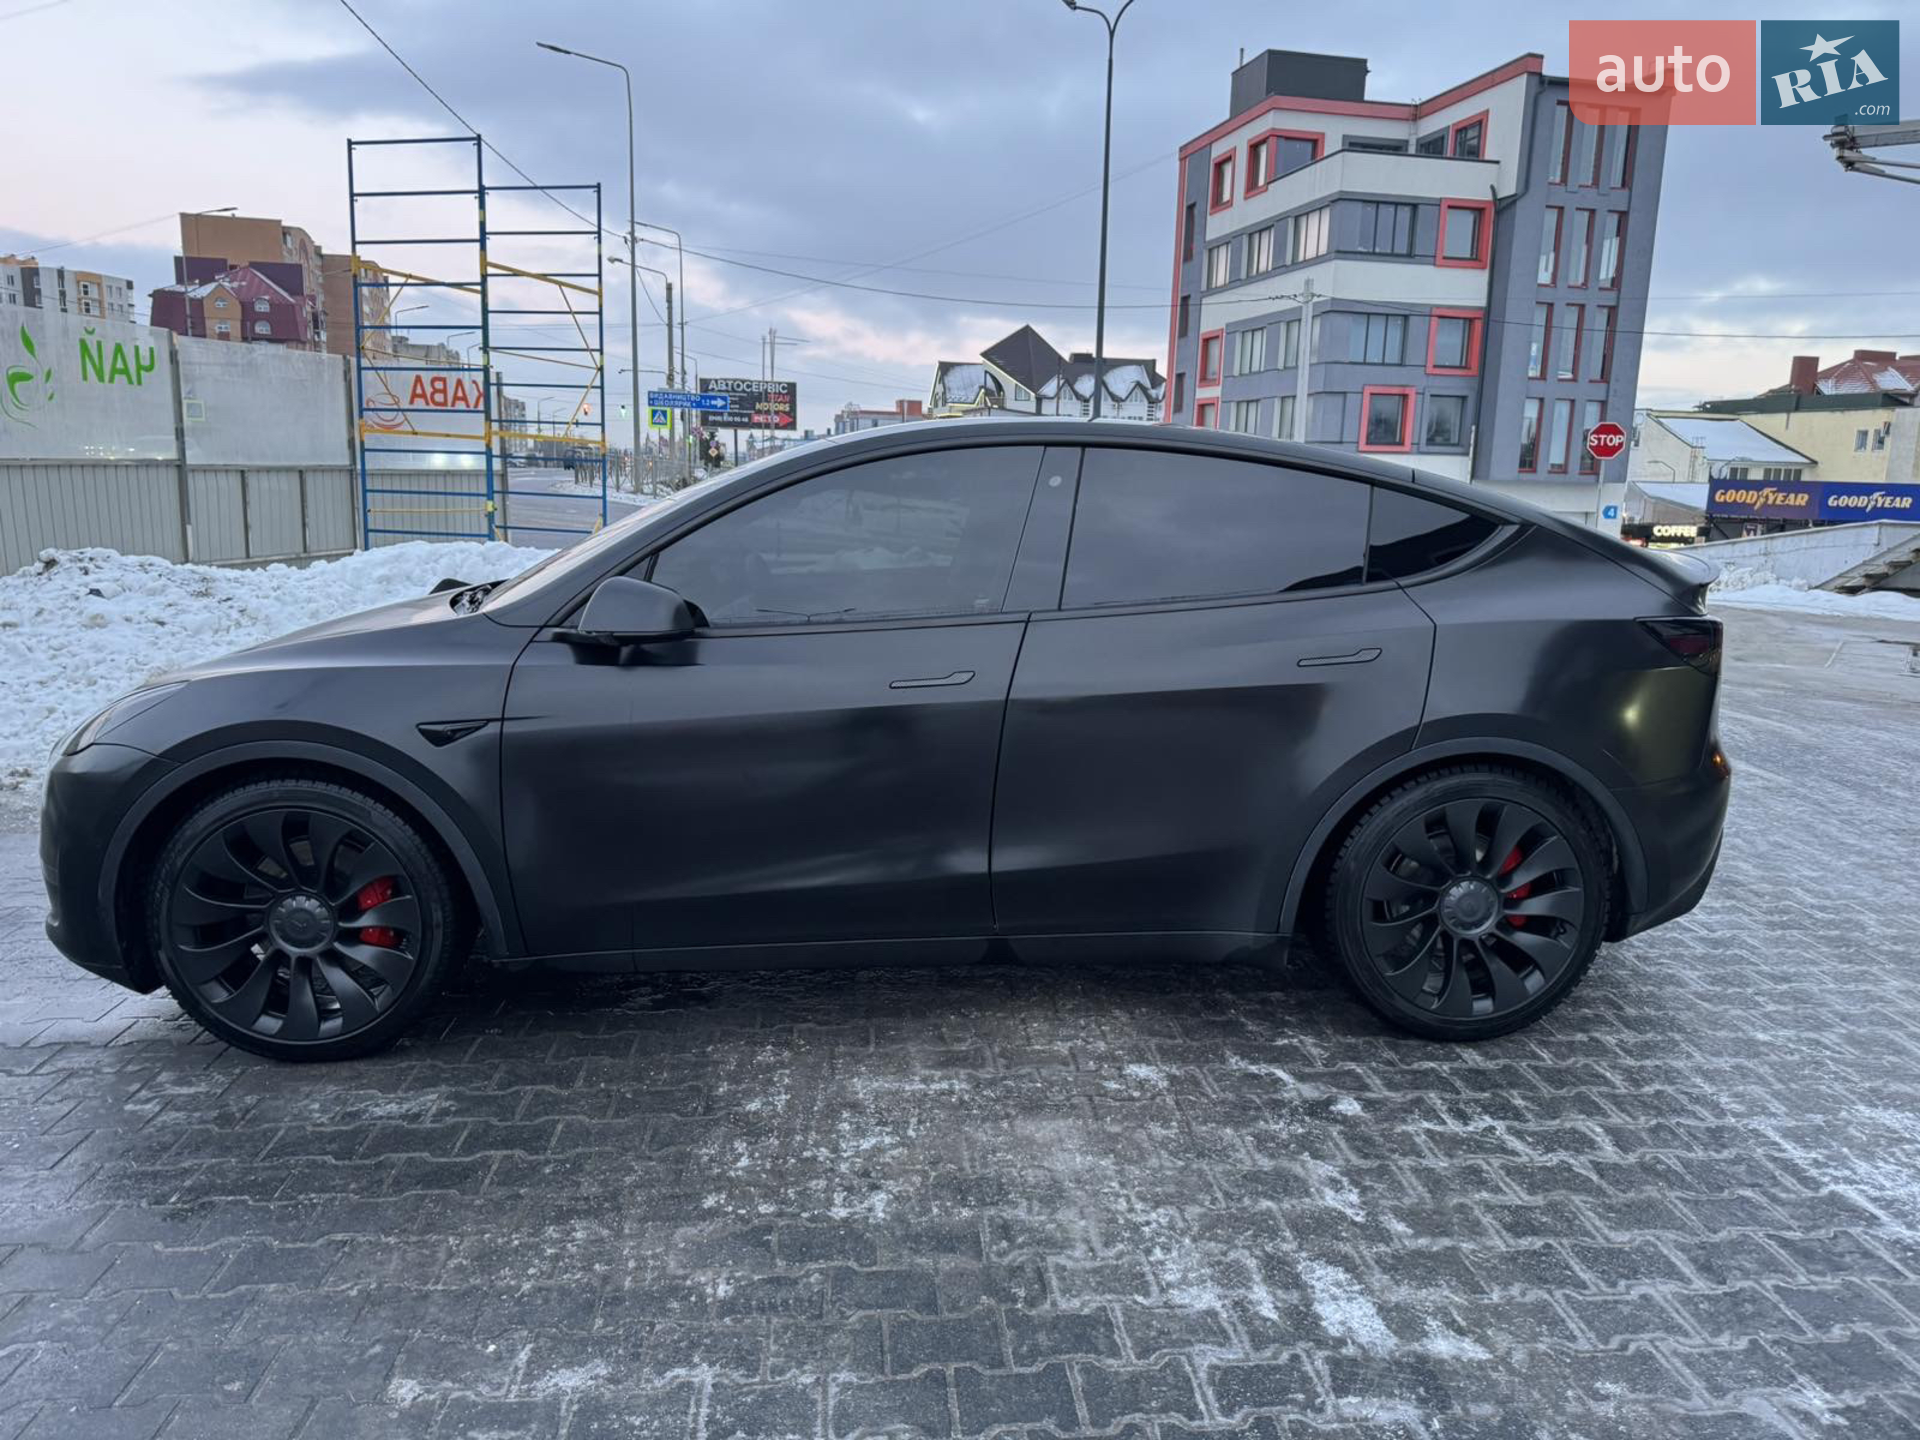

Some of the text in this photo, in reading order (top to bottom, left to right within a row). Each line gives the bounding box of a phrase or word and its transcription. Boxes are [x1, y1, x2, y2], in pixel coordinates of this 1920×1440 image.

[708, 379, 788, 393] АВТОСЕРВІС
[1589, 434, 1625, 447] STOP
[1653, 525, 1697, 537] COFFEE
